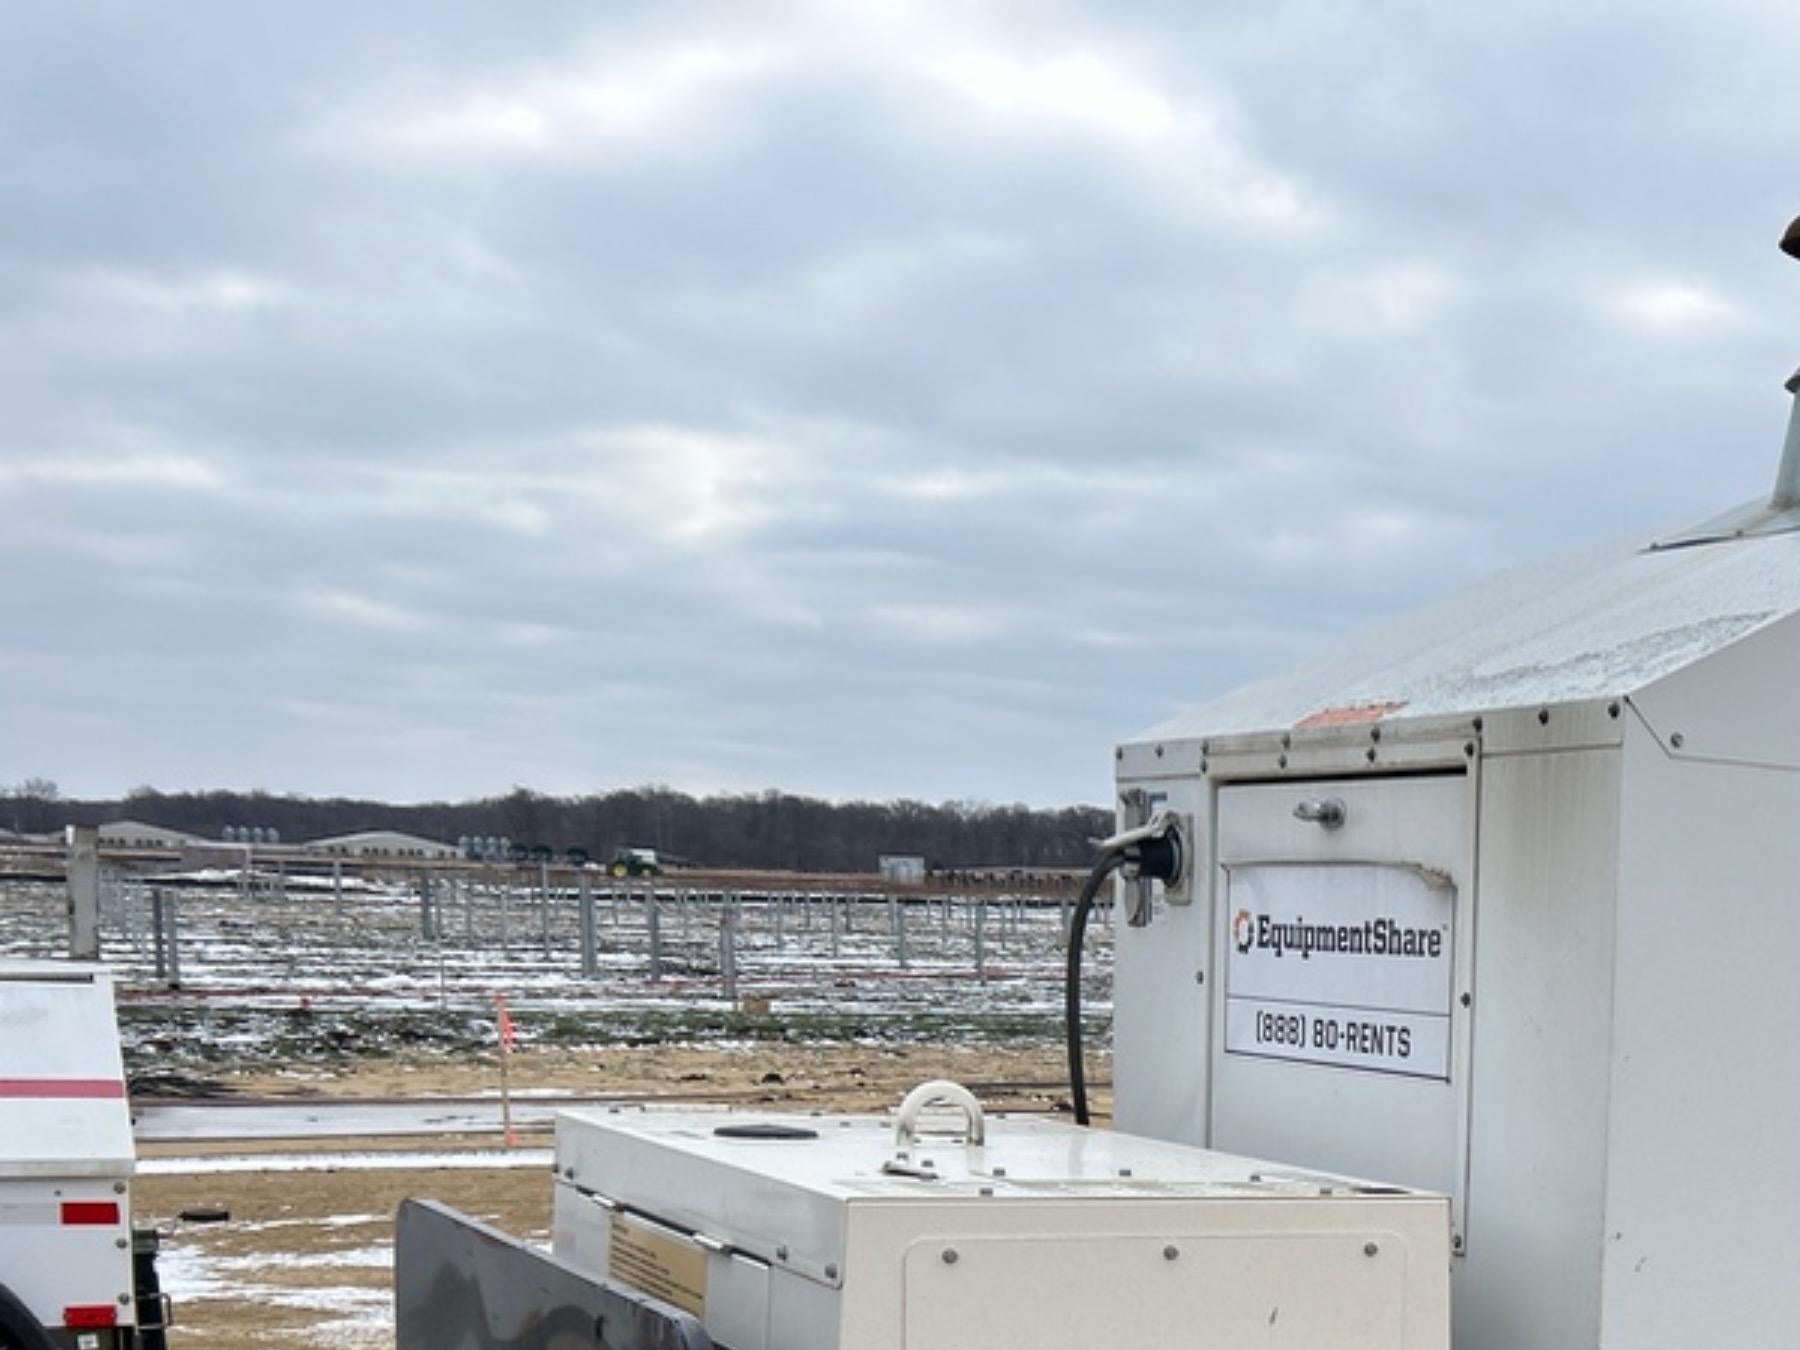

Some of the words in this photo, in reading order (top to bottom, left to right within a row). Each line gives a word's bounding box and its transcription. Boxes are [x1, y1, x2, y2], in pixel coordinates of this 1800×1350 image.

[1256, 914, 1442, 960] EquipmentShare
[1256, 1011, 1306, 1048] (888)
[1313, 1018, 1412, 1058] 80-RENTS
